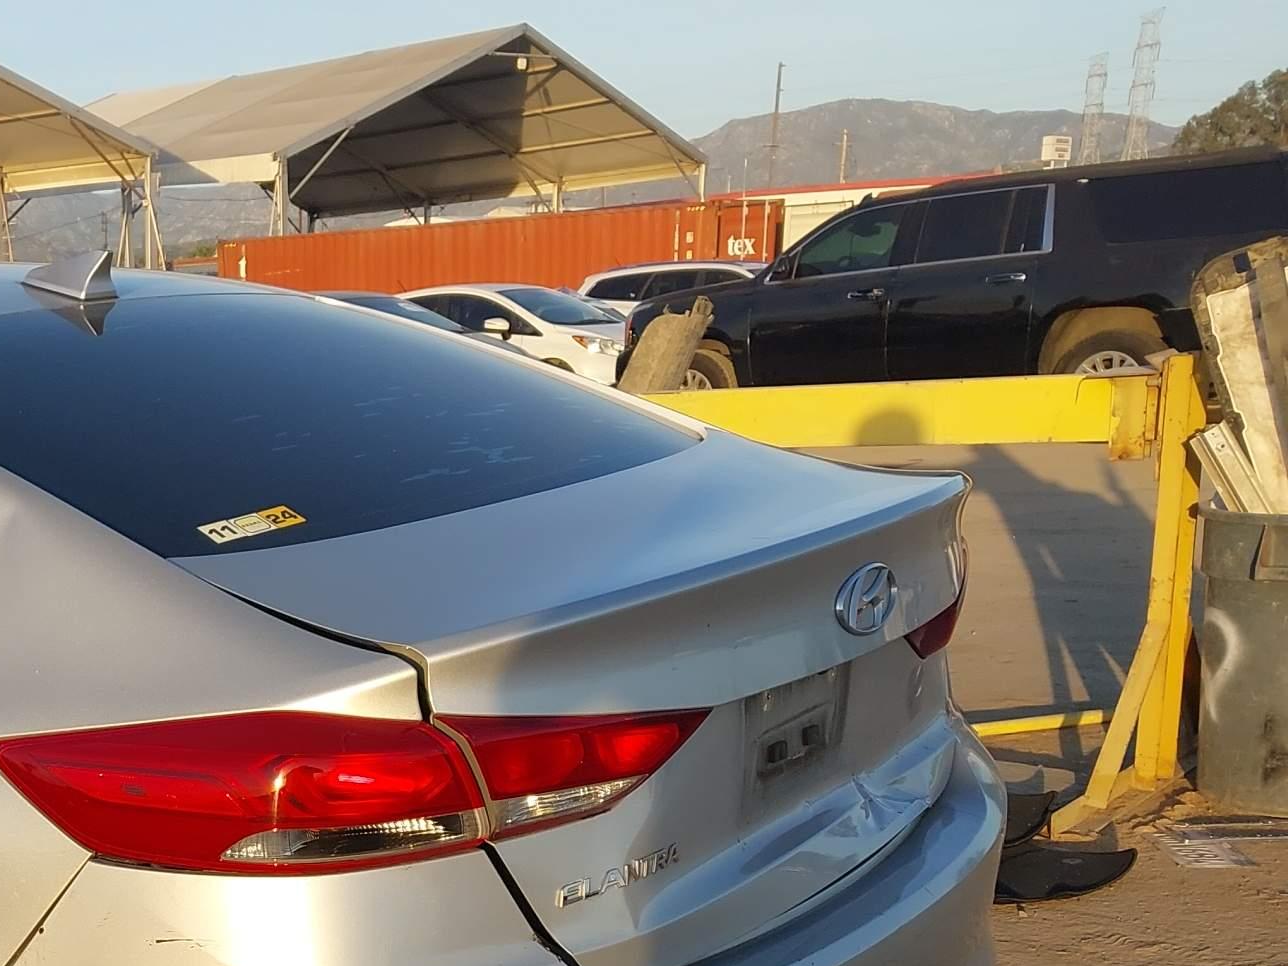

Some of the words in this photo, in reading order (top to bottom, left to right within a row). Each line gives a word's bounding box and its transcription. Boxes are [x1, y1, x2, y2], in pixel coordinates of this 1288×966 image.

[726, 234, 756, 257] tex
[207, 525, 238, 539] 11
[265, 509, 298, 524] 24
[555, 842, 680, 909] ELANTRA
